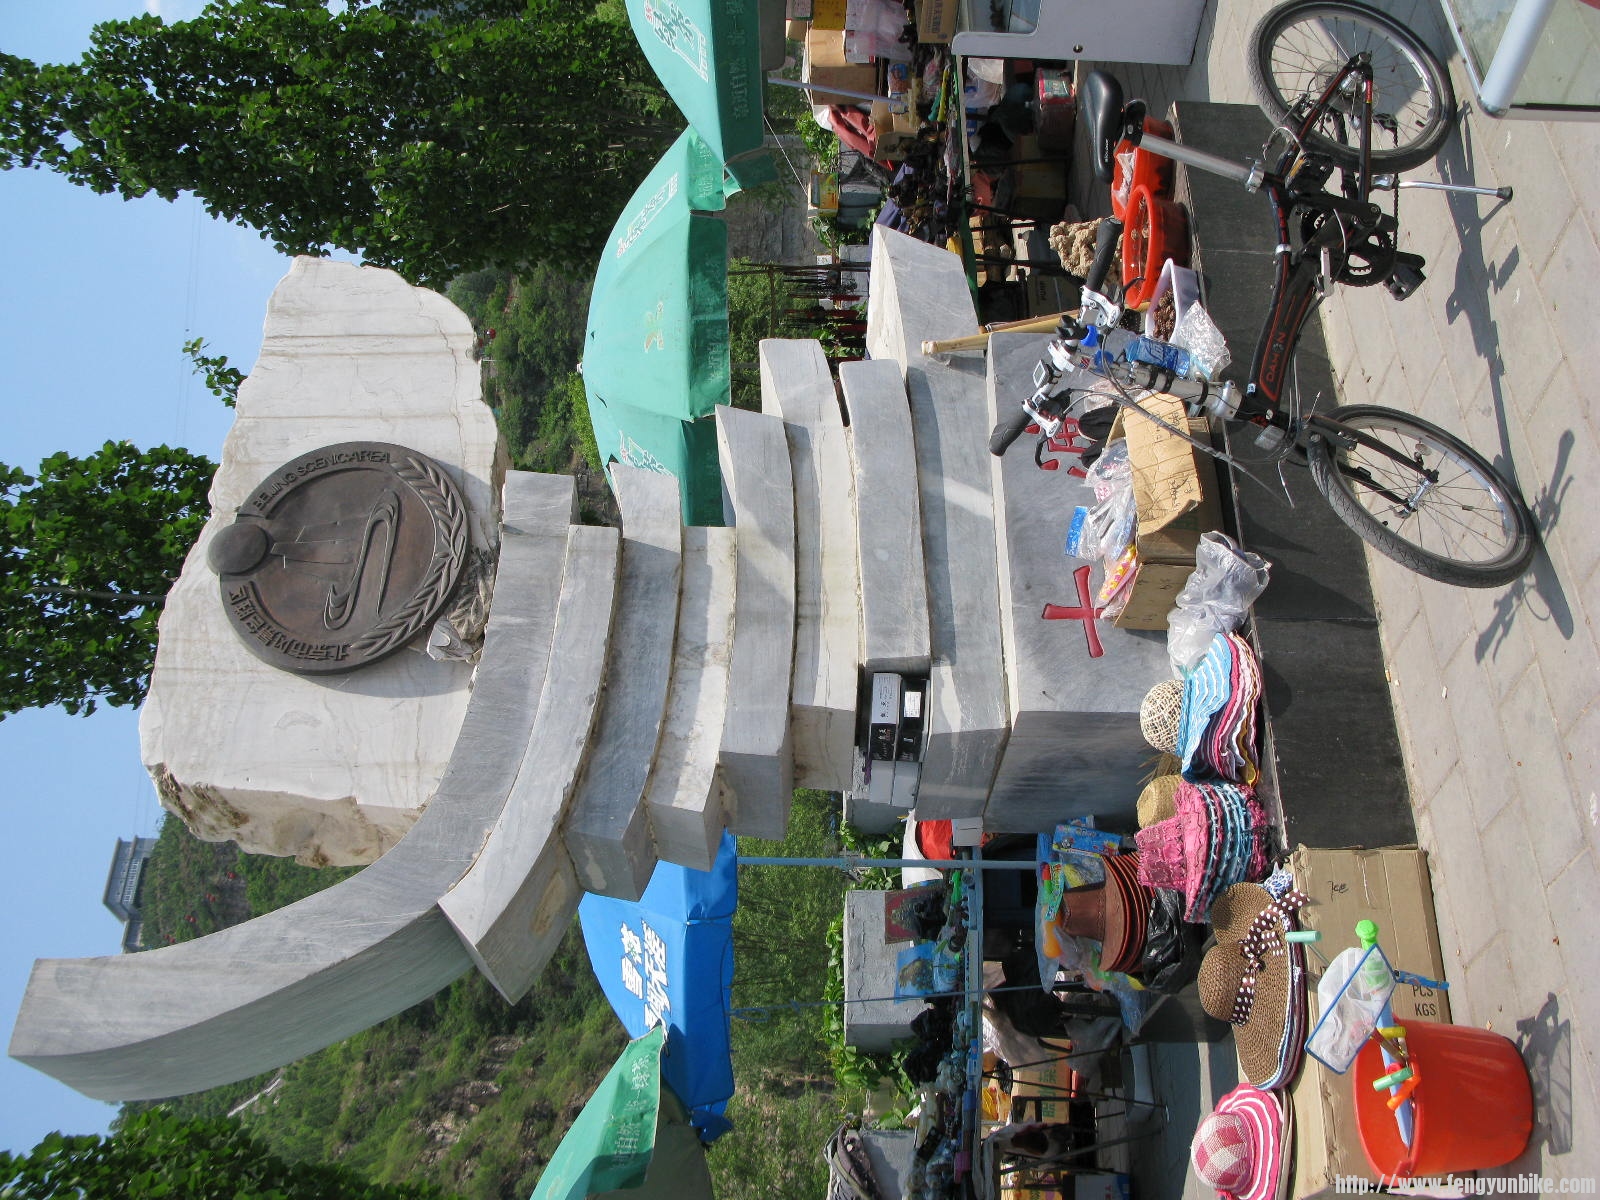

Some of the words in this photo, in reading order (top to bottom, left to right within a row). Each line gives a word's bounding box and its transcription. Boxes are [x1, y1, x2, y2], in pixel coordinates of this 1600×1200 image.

[253, 473, 296, 511] BEIJING
[297, 453, 346, 476] SCENIC
[229, 585, 351, 661] 北京市风景名胜区
[620, 922, 642, 999] 雪花
[1411, 983, 1434, 998] PCS
[1414, 1002, 1437, 1017] KGS
